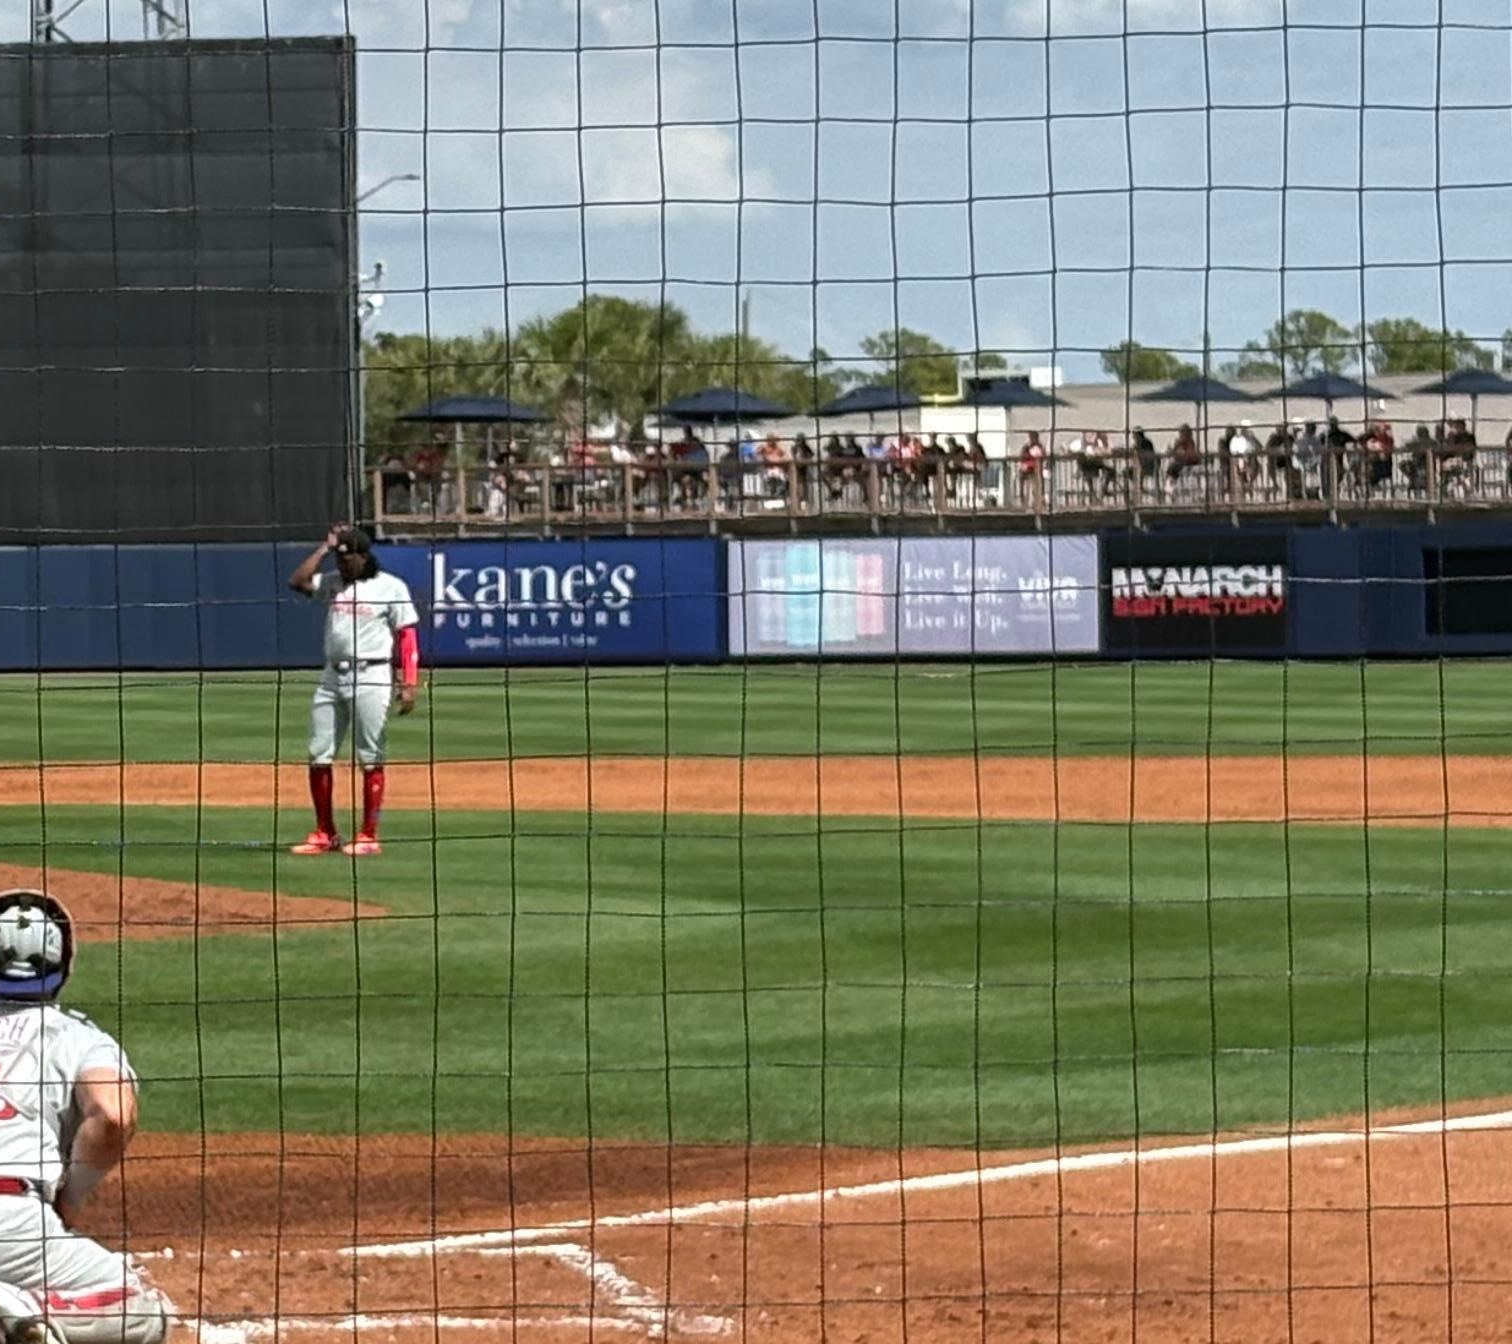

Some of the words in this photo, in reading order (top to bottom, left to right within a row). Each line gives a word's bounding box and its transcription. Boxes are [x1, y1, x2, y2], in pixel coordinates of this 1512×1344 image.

[904, 561, 945, 580] Live
[432, 553, 637, 609] kane's
[433, 610, 632, 629] FURNITURE
[904, 609, 946, 630] Live
